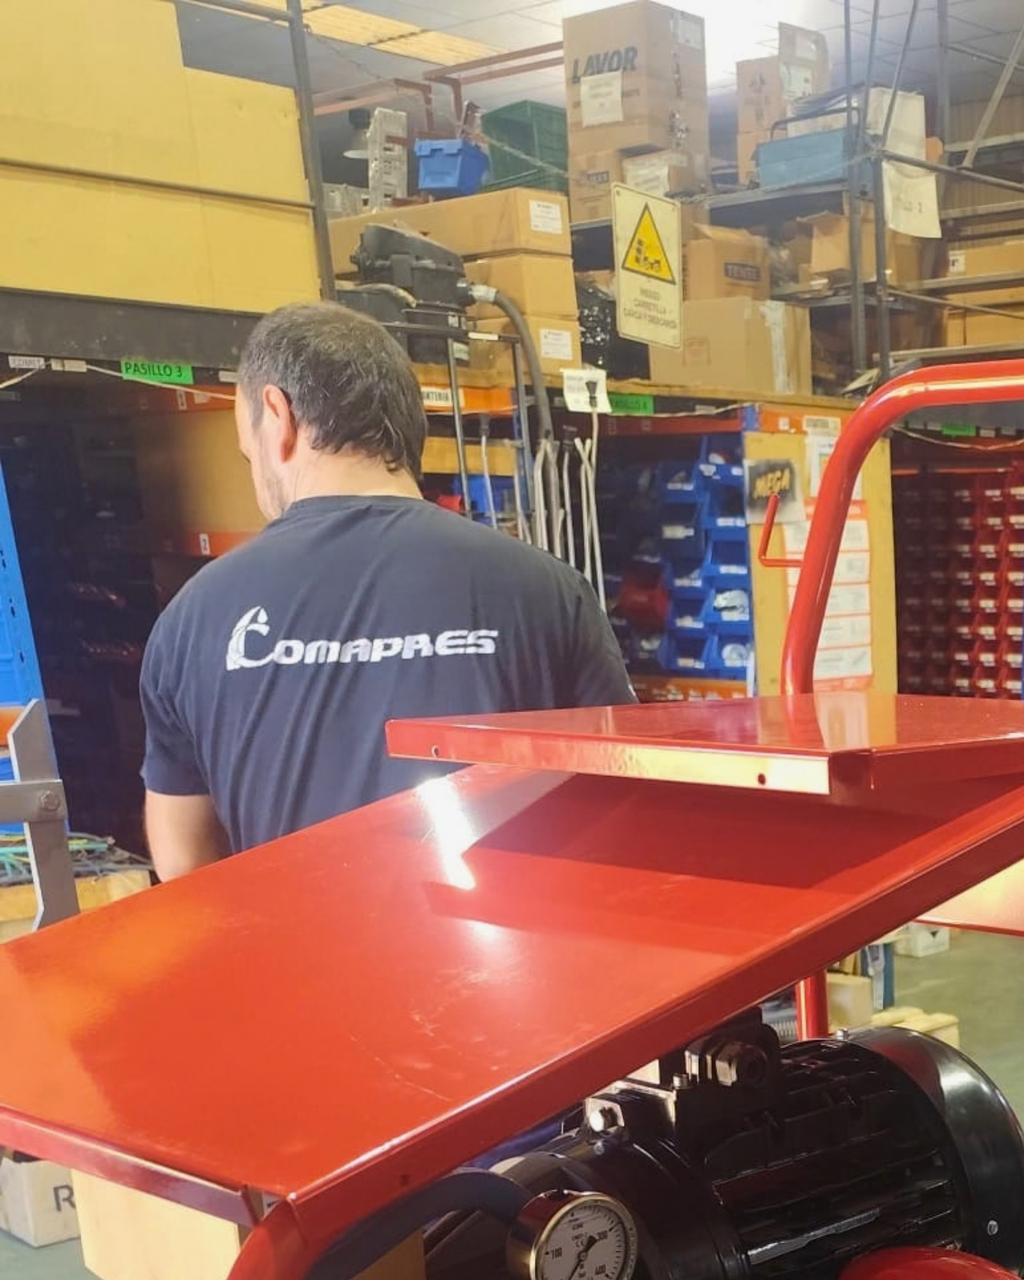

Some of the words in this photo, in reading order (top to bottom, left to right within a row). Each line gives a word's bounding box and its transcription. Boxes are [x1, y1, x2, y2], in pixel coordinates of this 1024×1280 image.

[571, 46, 638, 84] LAVOR
[124, 361, 173, 377] PASILLO
[175, 365, 183, 378] 3
[226, 605, 499, 671] COMAPRES
